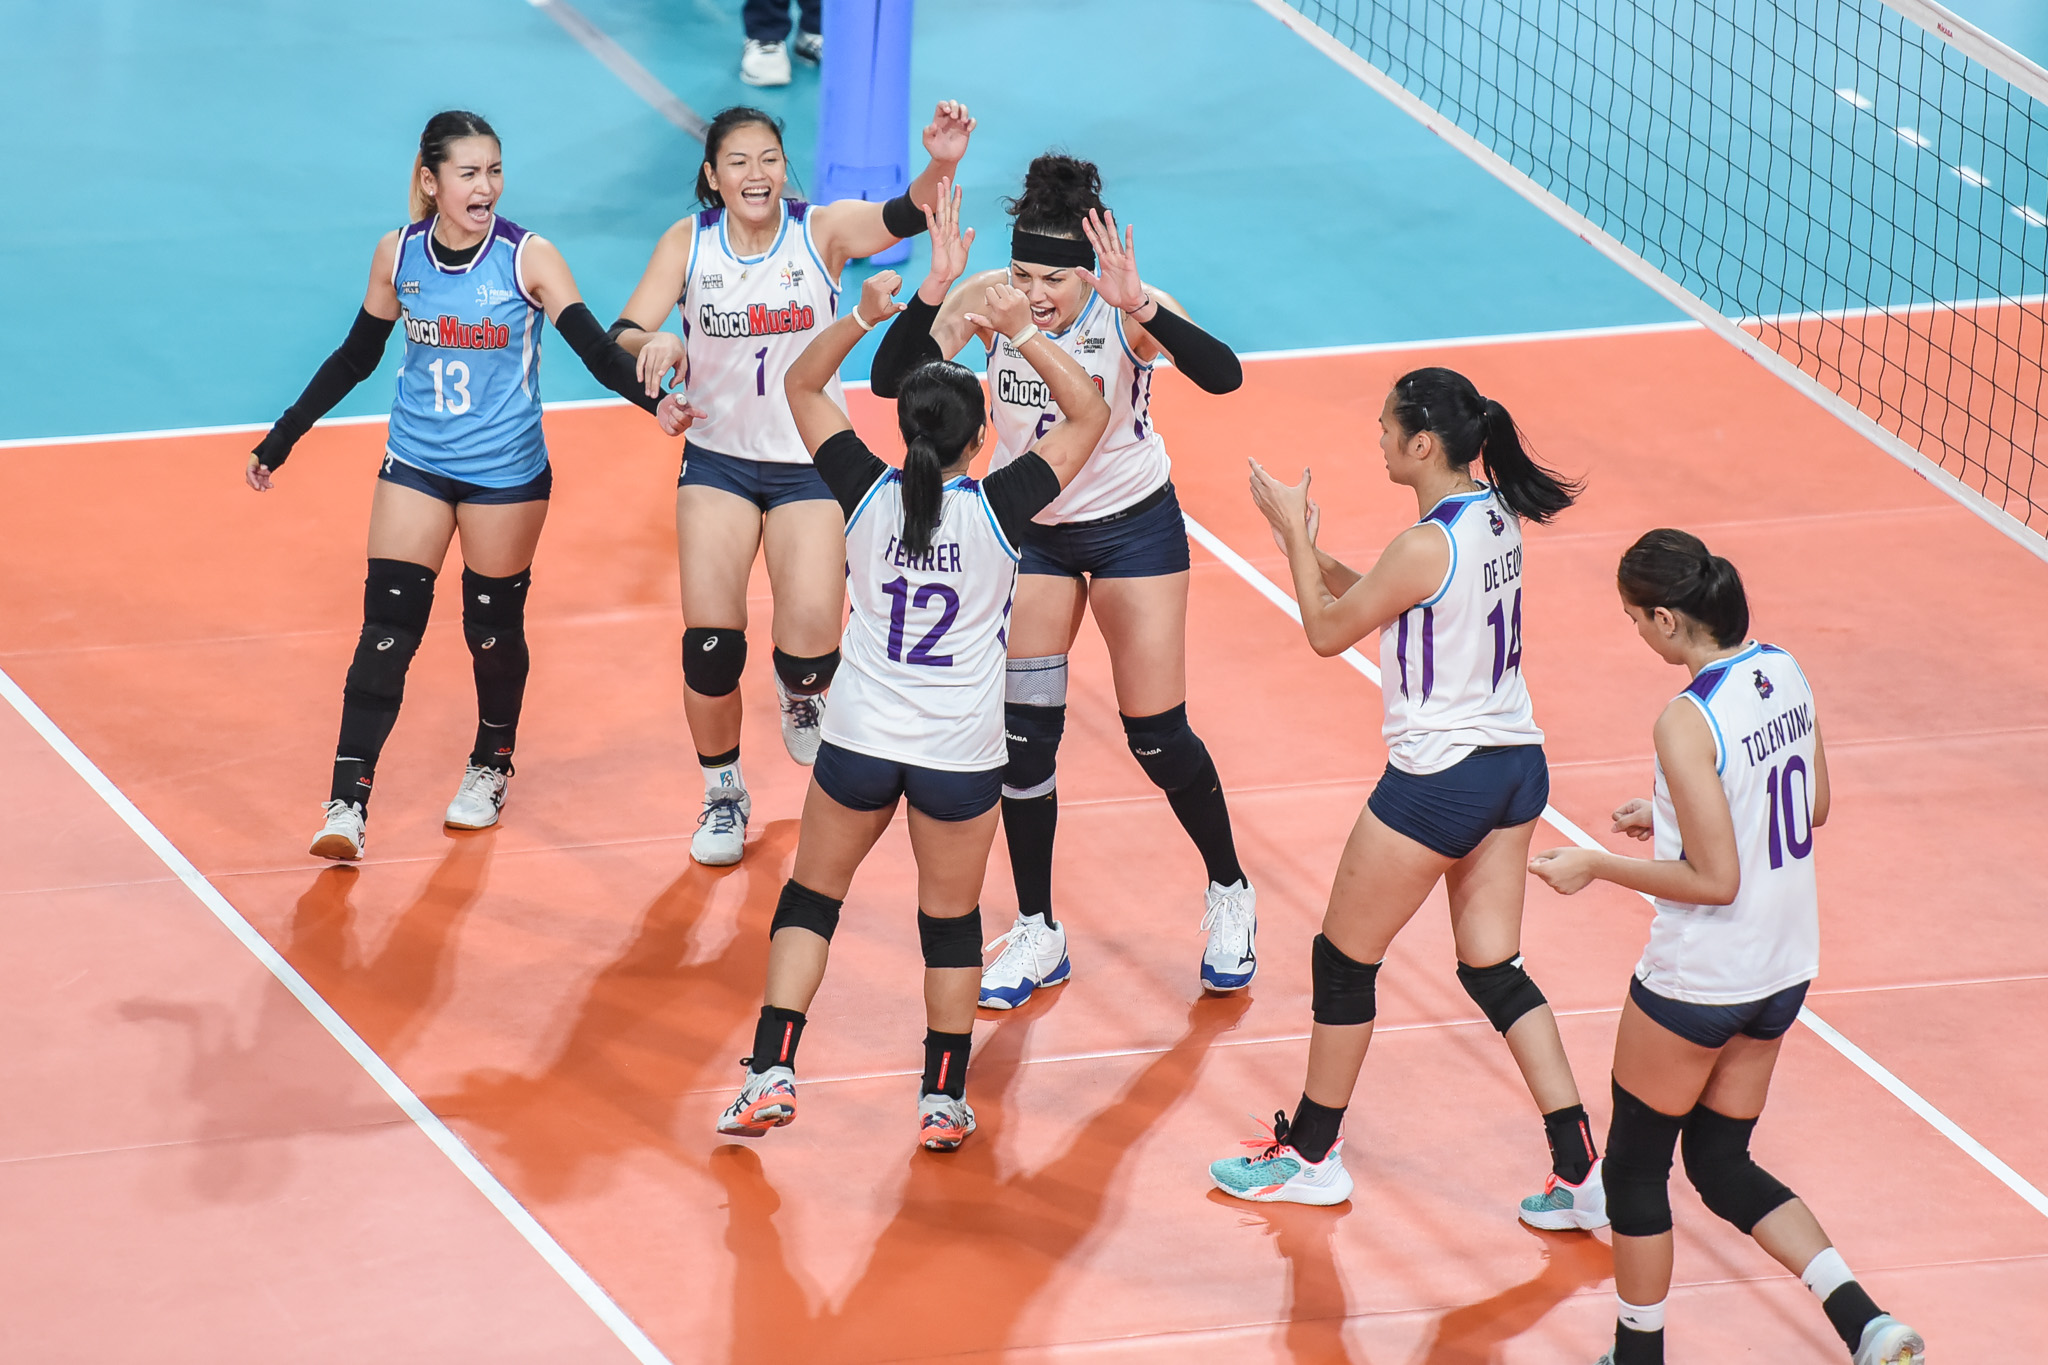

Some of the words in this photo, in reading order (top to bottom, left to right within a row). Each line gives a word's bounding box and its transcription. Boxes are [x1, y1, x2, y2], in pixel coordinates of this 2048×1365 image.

[402, 306, 509, 349] hocoMucho
[429, 358, 471, 415] 13
[755, 347, 768, 396] 1
[1484, 558, 1500, 593] DE
[882, 575, 960, 666] 12
[1487, 587, 1522, 693] 14
[1767, 755, 1812, 870] 10
